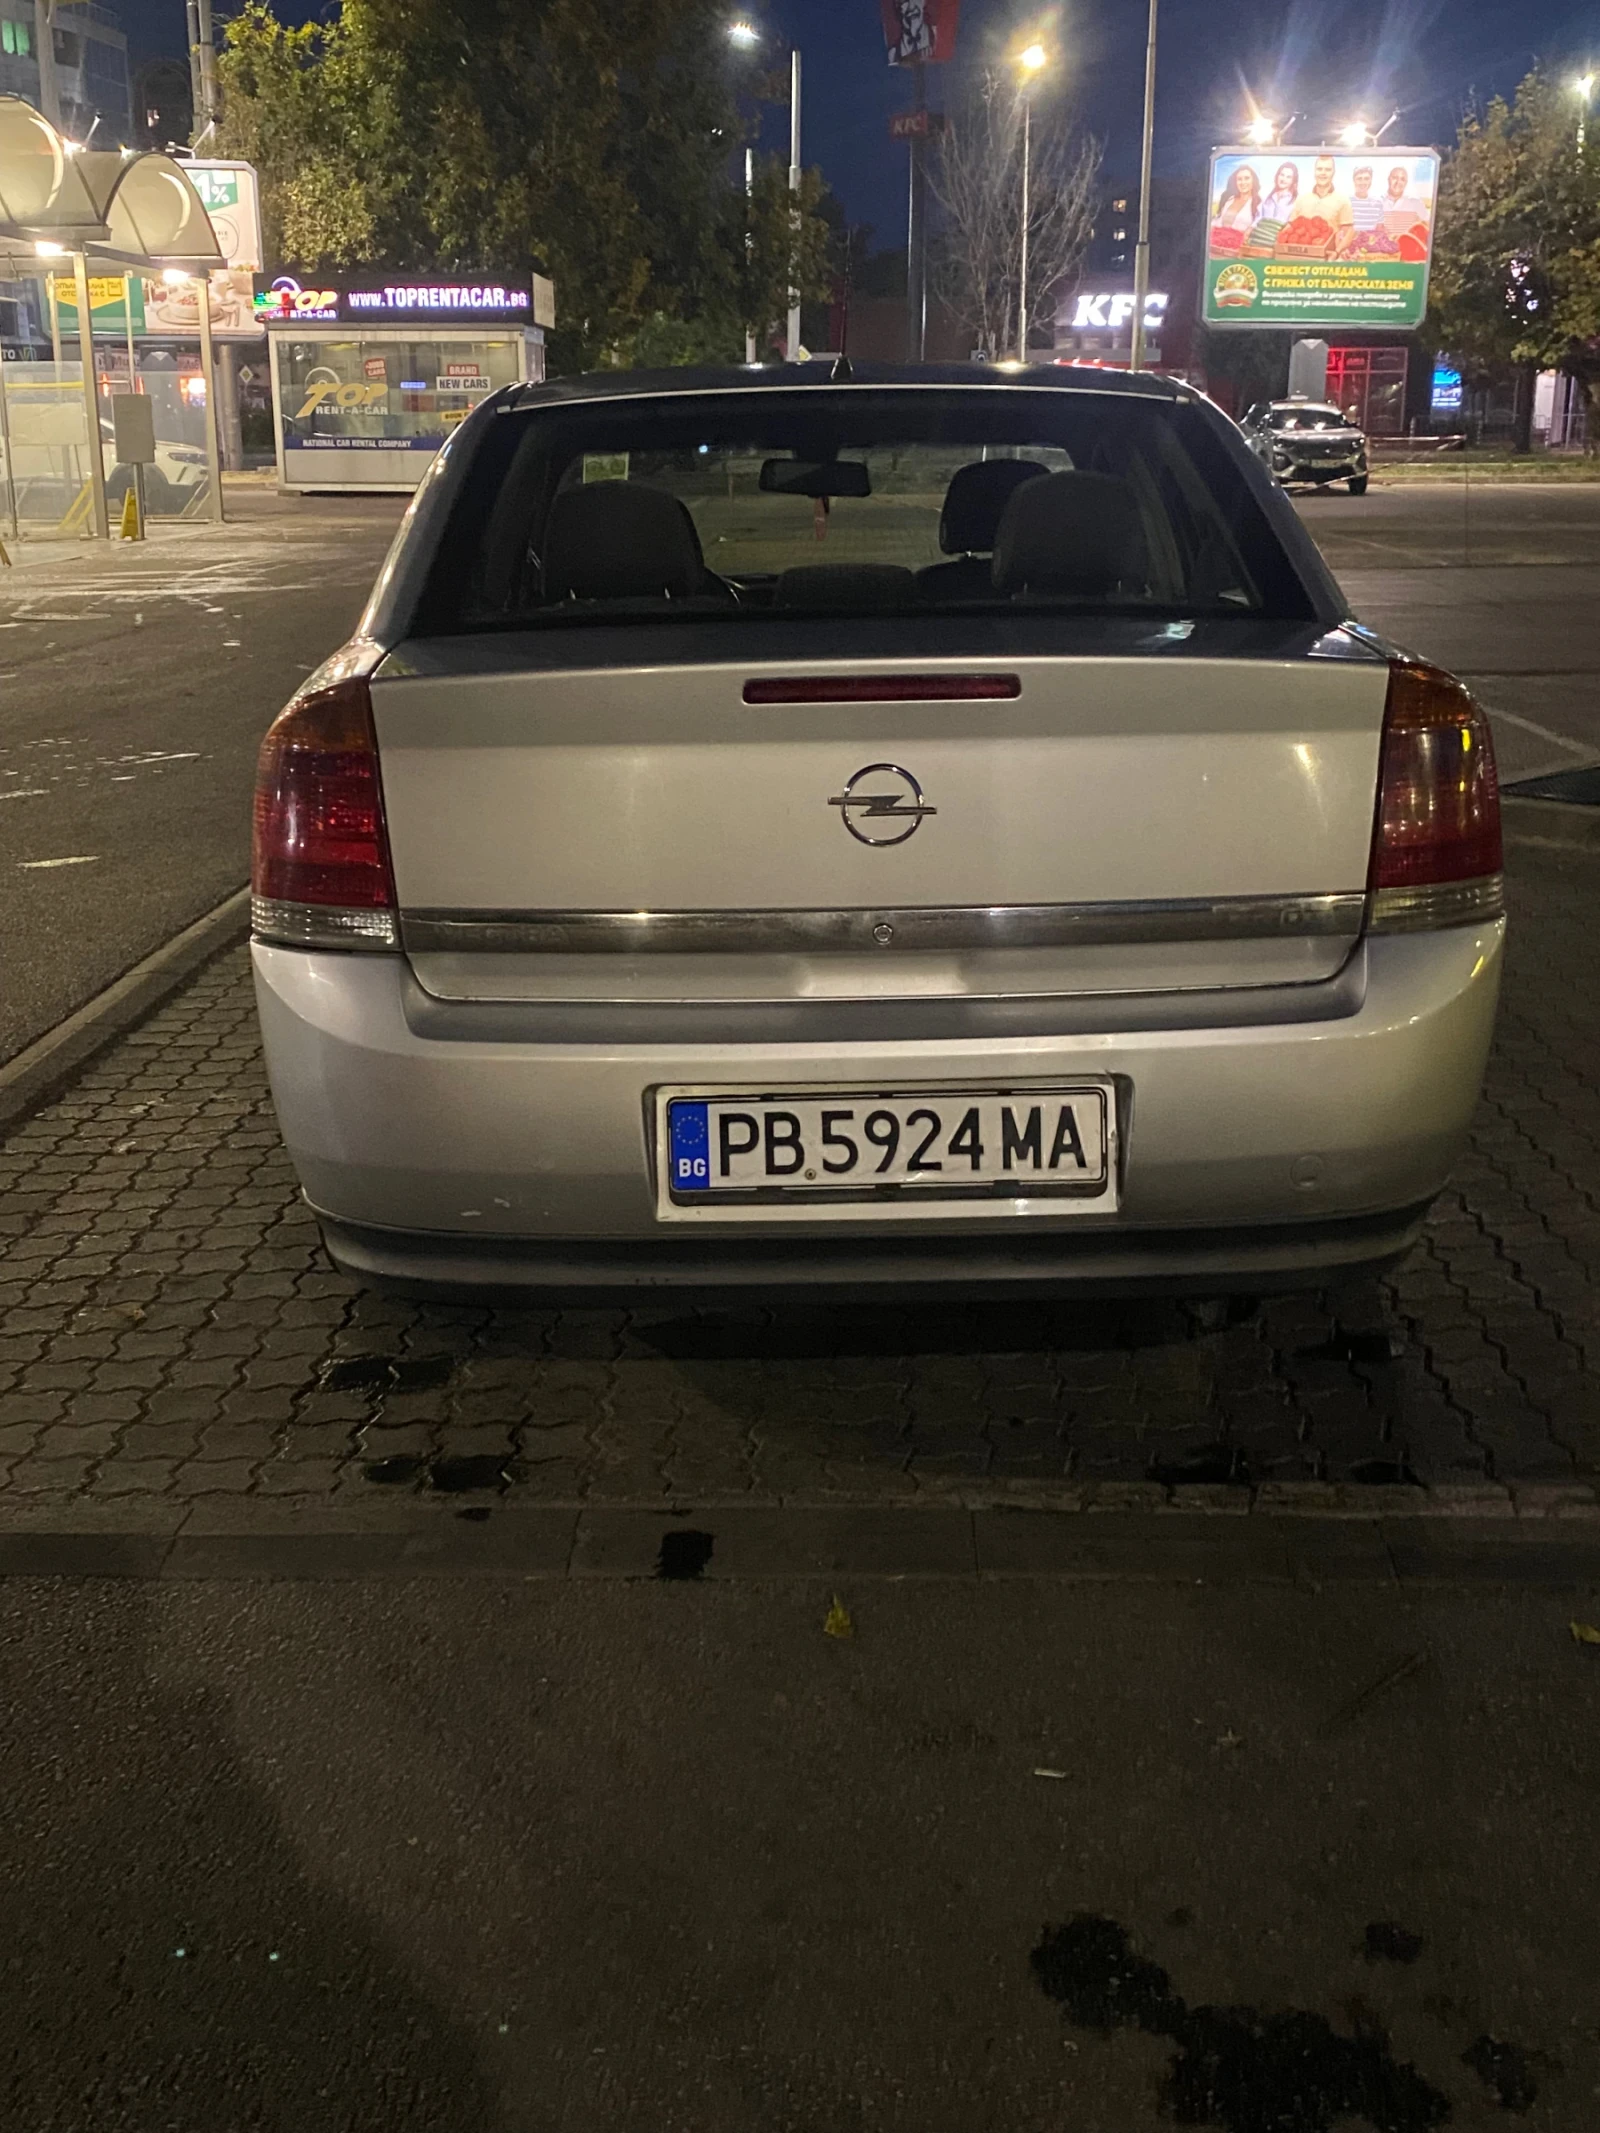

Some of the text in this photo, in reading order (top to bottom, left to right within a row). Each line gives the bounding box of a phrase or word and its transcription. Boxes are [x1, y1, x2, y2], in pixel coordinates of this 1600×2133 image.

[1263, 265, 1310, 276] СВЕЖЕСТ
[1311, 266, 1368, 278] ОТГЛЕДАНА
[1262, 278, 1415, 290] С ГРИЖА ОТ БЪЛГАРСКАТА ЗЕМЯ
[1072, 293, 1168, 327] KFC
[449, 366, 477, 375] BRAND
[439, 377, 488, 389] NEW CARS
[295, 383, 388, 418] TOP
[315, 405, 389, 415] RENT-A-CAR
[302, 439, 335, 447] NATIONAL
[336, 439, 350, 447] CAR
[378, 440, 412, 448] COMPANY
[718, 1106, 1088, 1176] PB 5924 MA
[678, 1158, 707, 1178] BG
